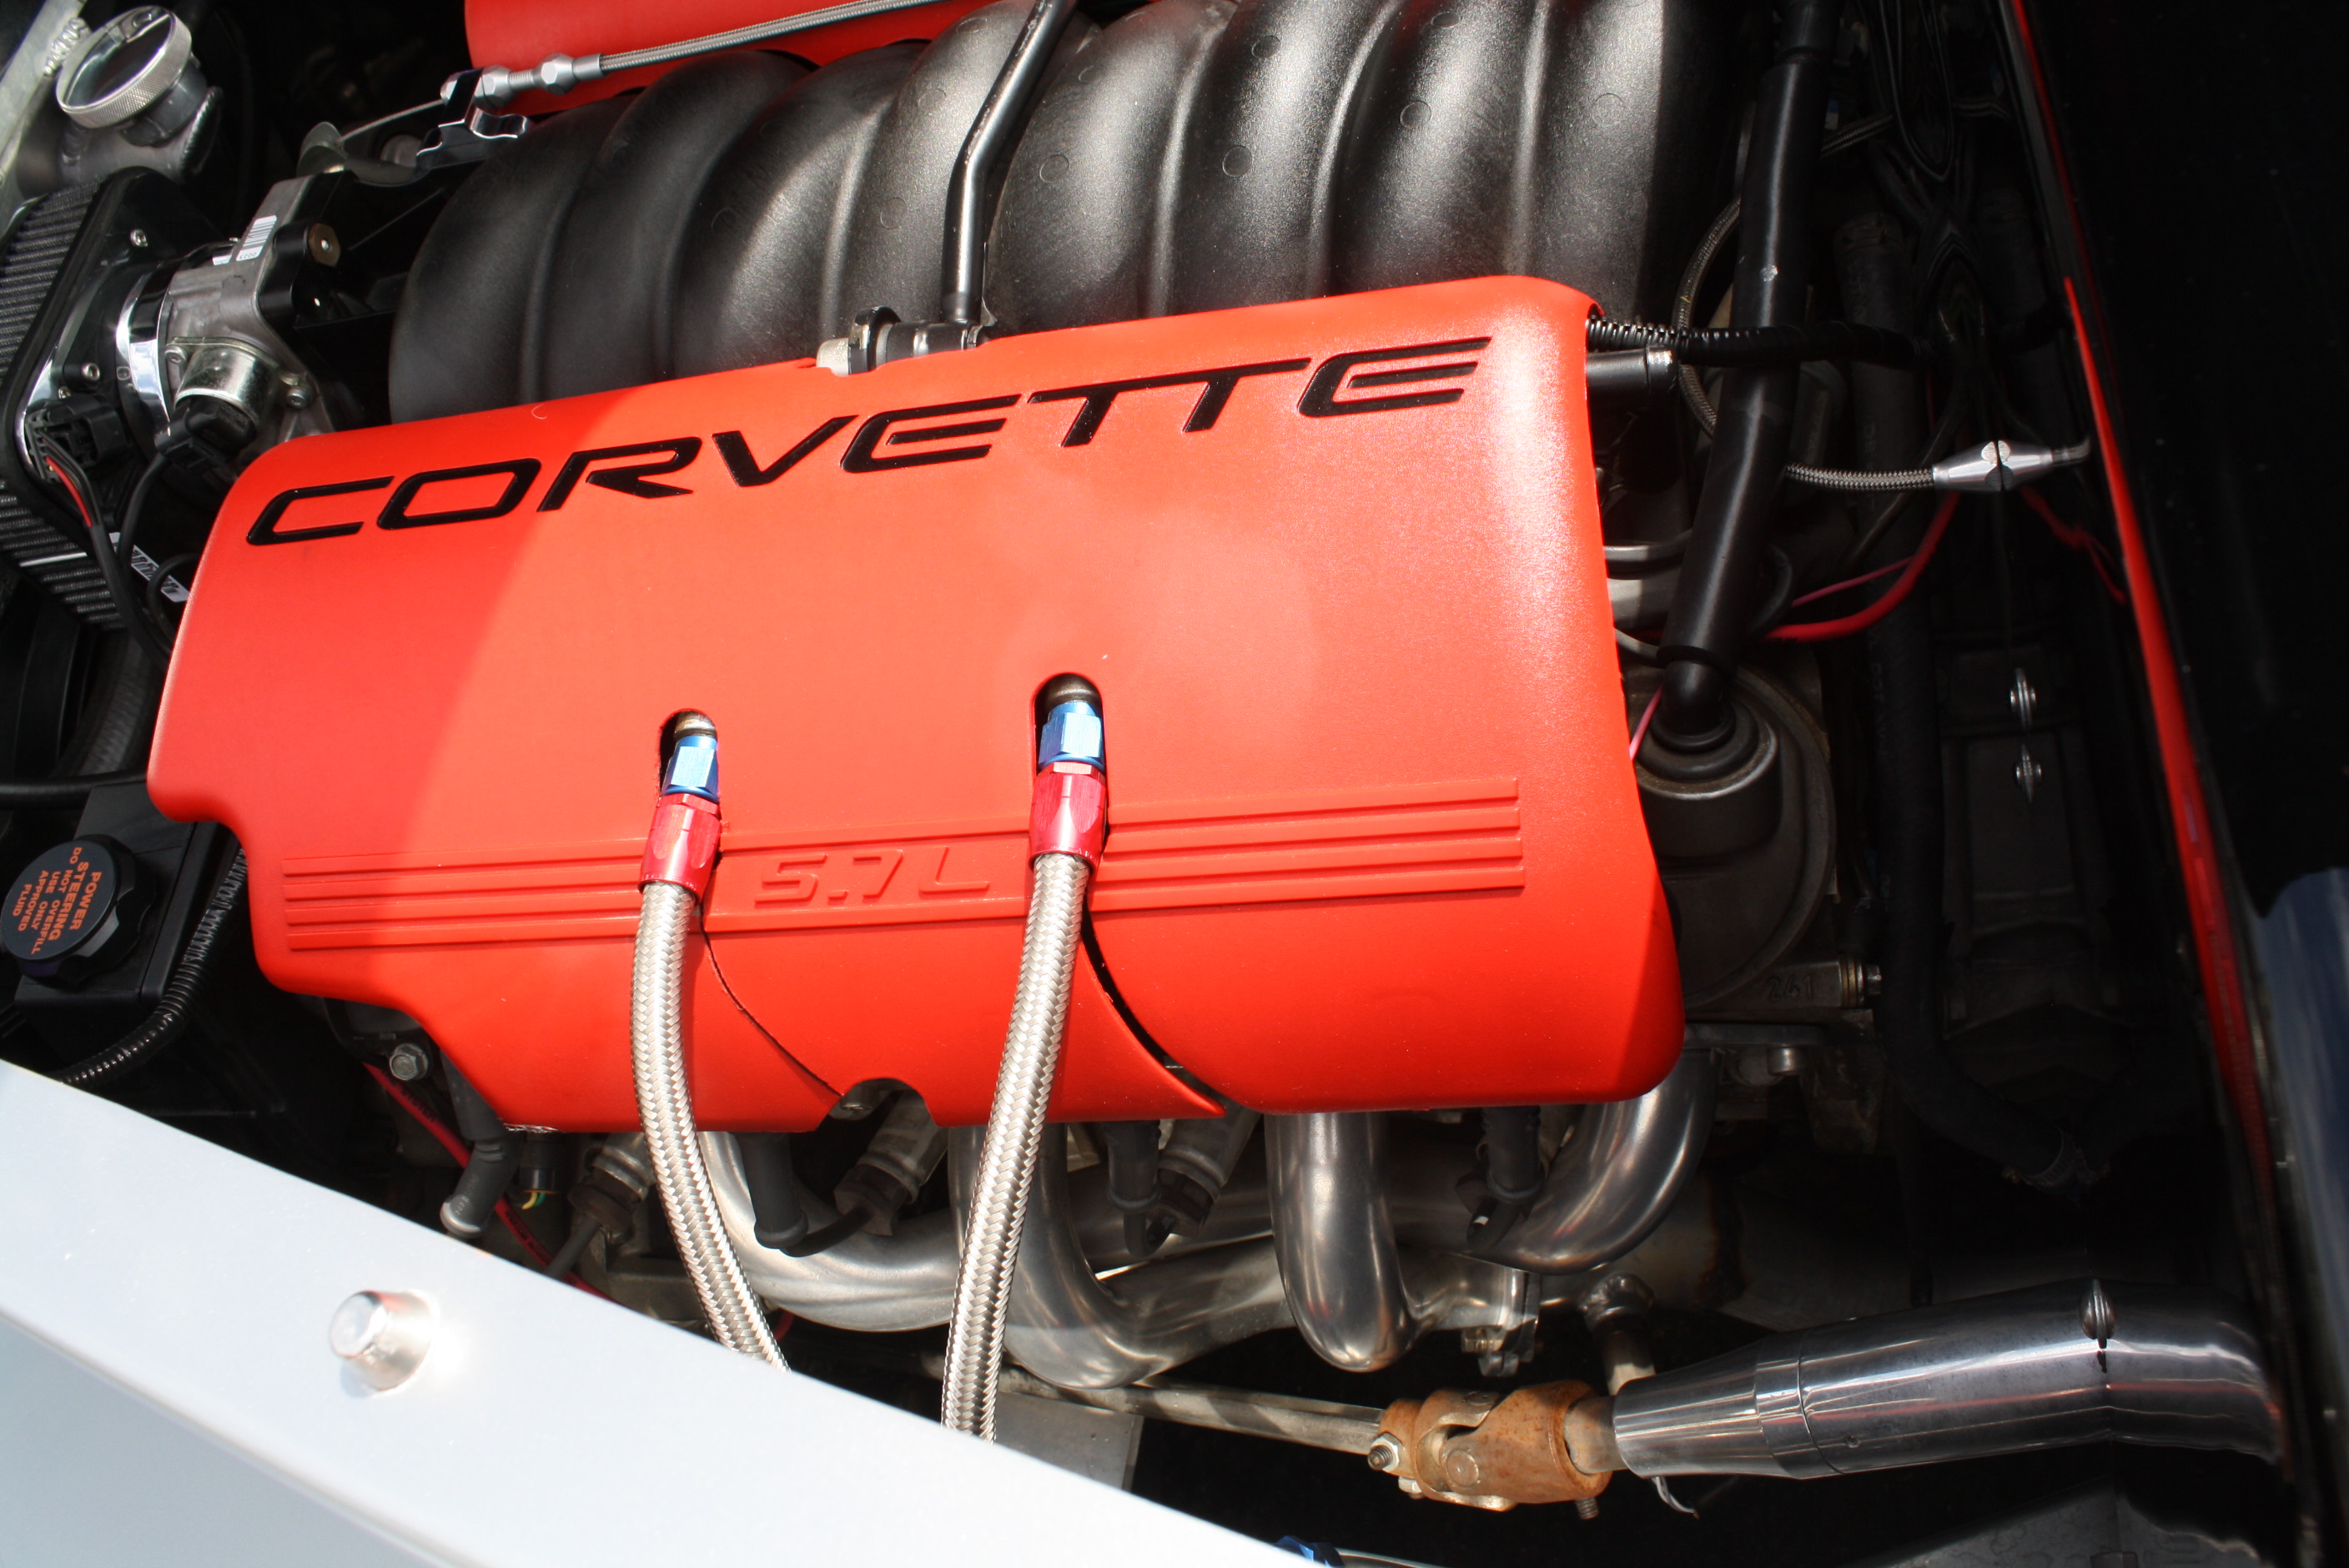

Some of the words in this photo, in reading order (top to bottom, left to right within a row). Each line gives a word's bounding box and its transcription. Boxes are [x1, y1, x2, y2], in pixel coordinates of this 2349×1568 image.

[246, 339, 1486, 546] CORVETTE
[69, 847, 83, 865] DO
[12, 884, 33, 917] FLUID
[18, 870, 49, 931] APPROVED
[45, 871, 62, 893] USE
[48, 862, 89, 941] STEERING
[58, 869, 73, 893] NOT
[69, 872, 103, 930] POWER
[31, 901, 48, 930] ONLY
[31, 899, 60, 955] OVERFILL
